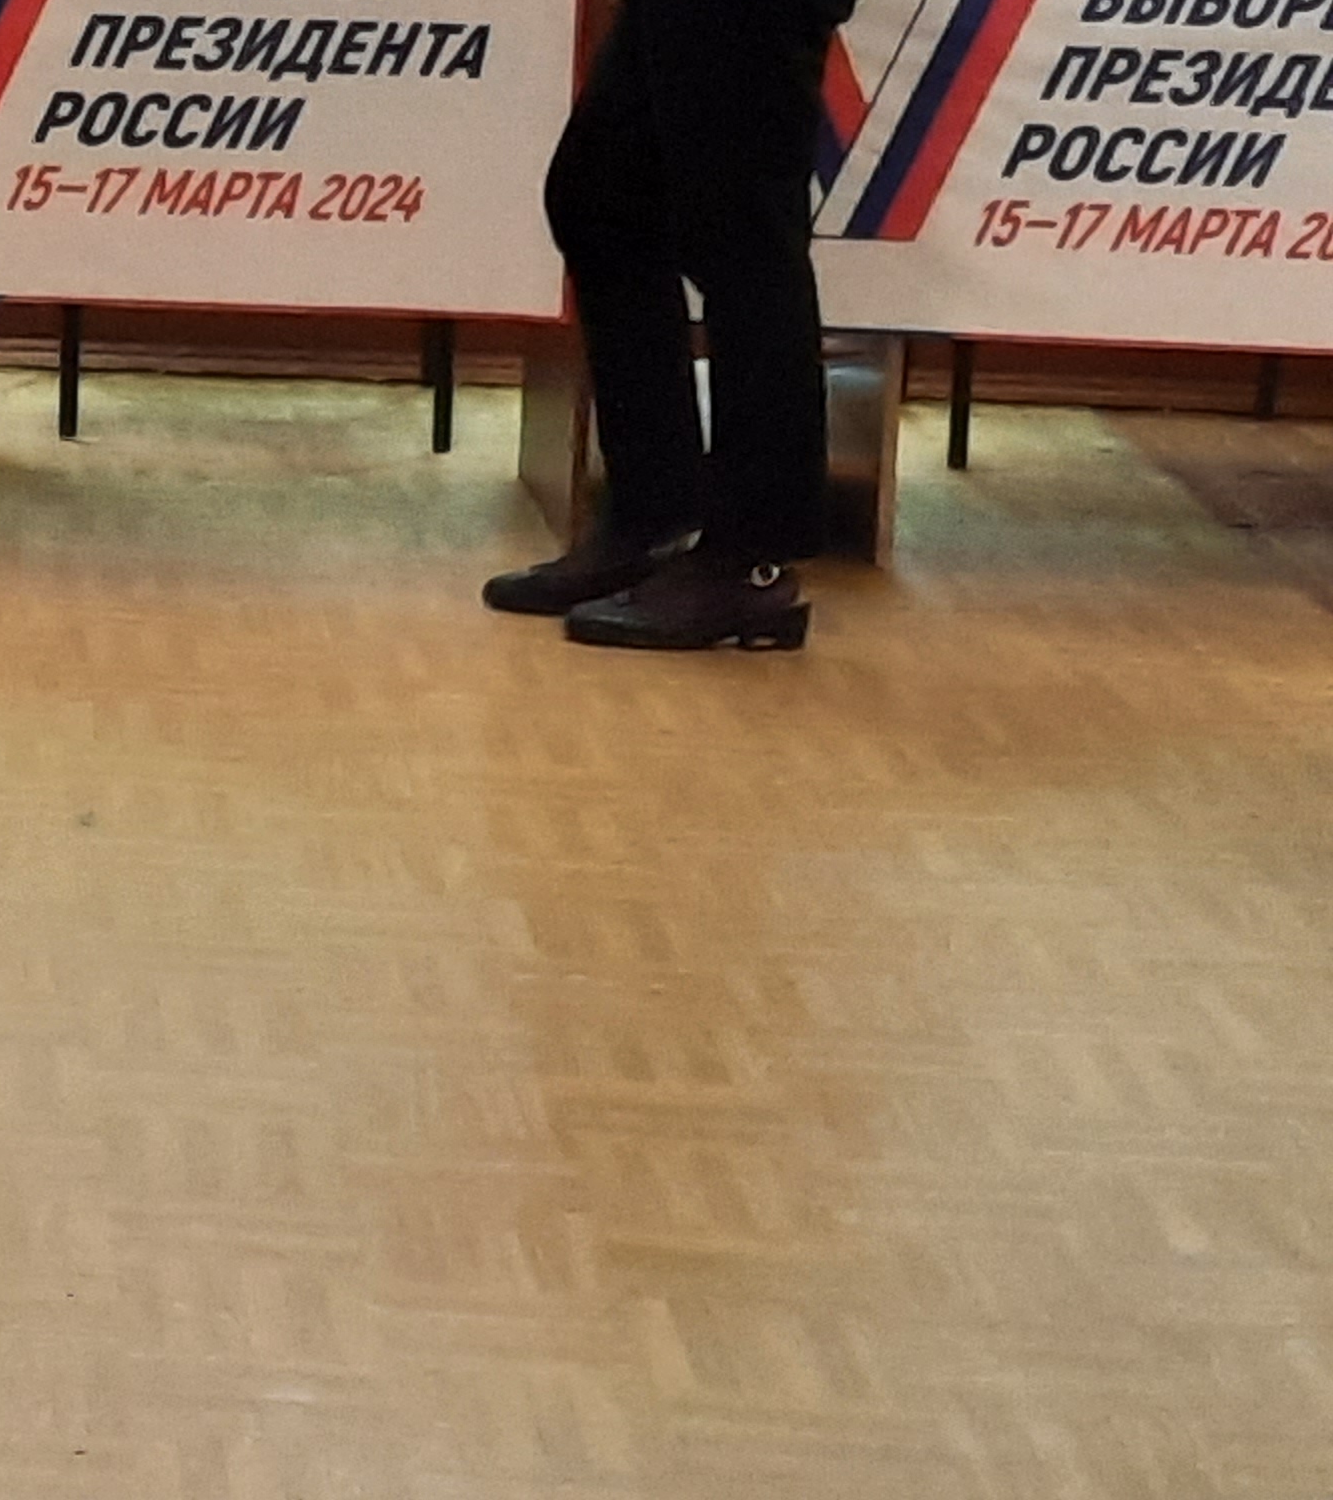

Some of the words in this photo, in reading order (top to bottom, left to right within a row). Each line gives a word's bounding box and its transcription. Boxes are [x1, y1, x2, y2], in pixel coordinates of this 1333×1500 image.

[70, 14, 491, 82] ПРЕЗИДЕНТА
[33, 91, 306, 151] РОССИИ
[1001, 123, 1286, 188] РОССИИ
[139, 168, 303, 220] МАРТА
[308, 173, 425, 222] 2024
[1109, 204, 1281, 257] МАРТА
